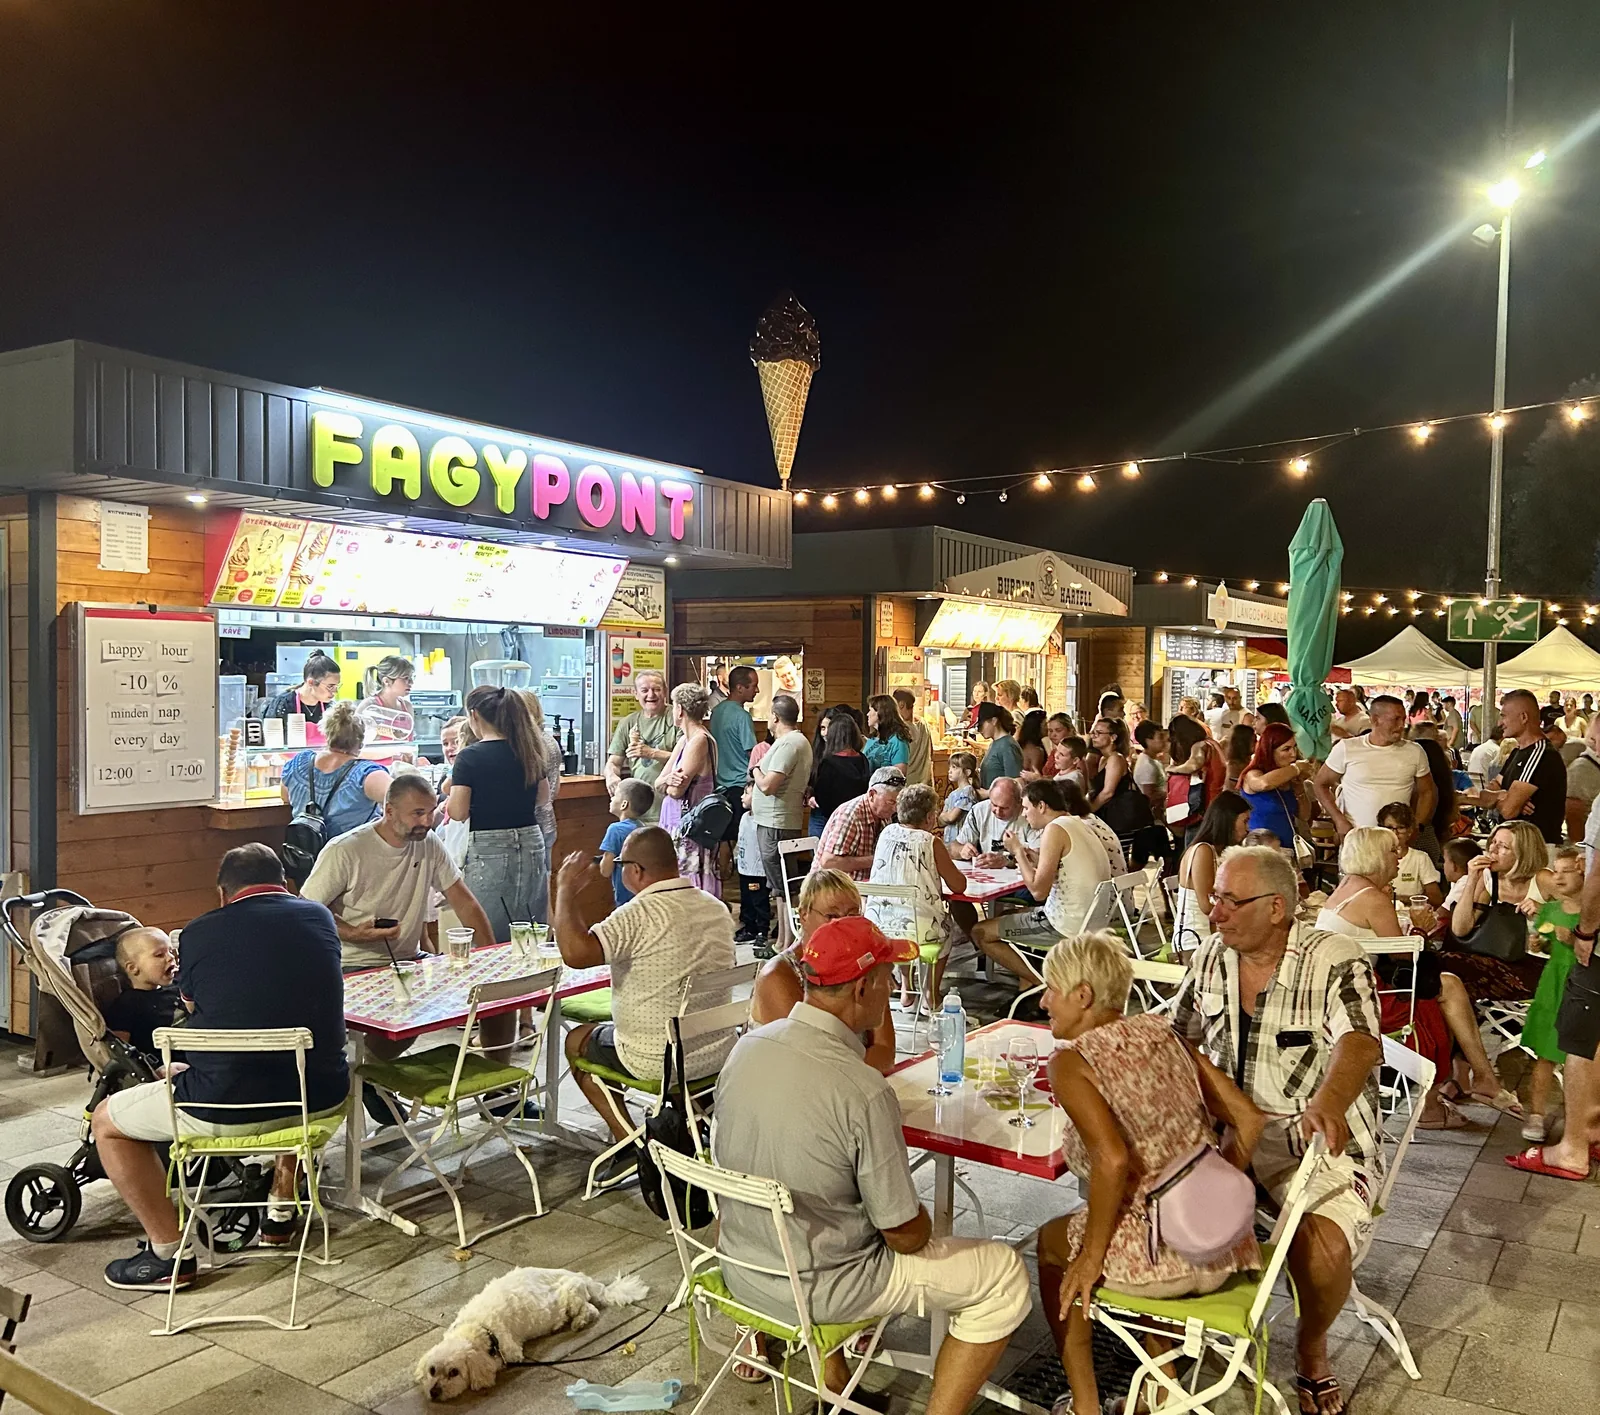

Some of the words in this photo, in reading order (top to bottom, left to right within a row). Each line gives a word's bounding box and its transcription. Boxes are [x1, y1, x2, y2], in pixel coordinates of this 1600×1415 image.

[312, 410, 694, 541] FAGYPONT
[222, 626, 241, 635] KÁVÉ
[108, 643, 144, 658] happy
[161, 644, 188, 656] hour
[121, 674, 147, 690] -10
[162, 675, 178, 690] %
[110, 708, 149, 718] minden
[158, 708, 180, 720] nap
[114, 736, 147, 748] every
[159, 733, 180, 746] day
[98, 767, 133, 781] 12:00
[170, 764, 203, 777] 17:00
